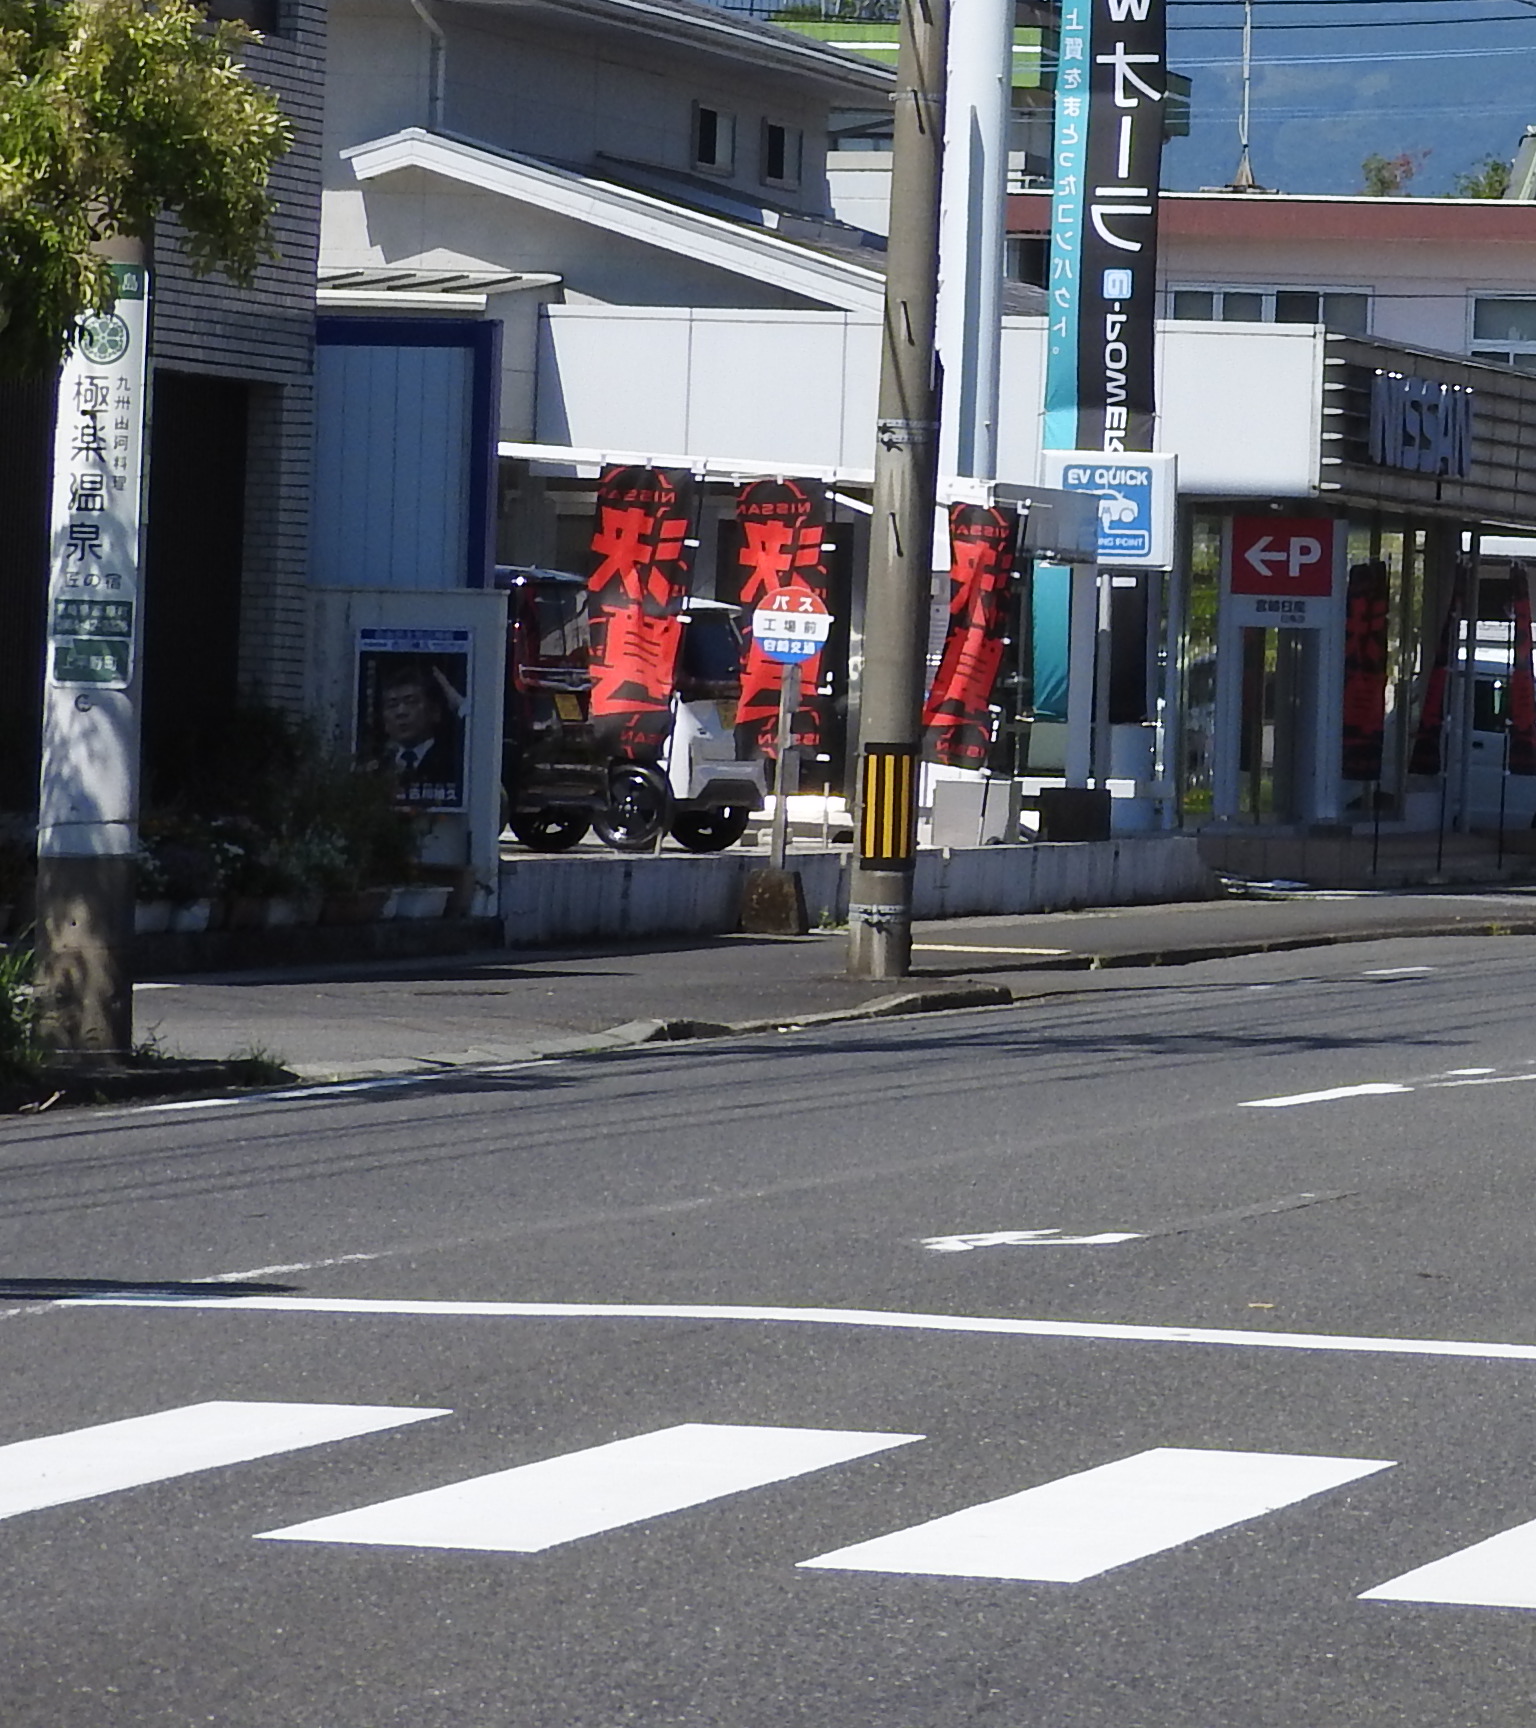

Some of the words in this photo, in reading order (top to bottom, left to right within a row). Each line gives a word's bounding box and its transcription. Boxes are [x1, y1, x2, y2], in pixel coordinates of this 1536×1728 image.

[1369, 370, 1473, 479] NISSAN
[67, 373, 110, 562] 極楽温泉
[1068, 468, 1091, 484] EV
[1095, 469, 1148, 485] QUICK
[1289, 536, 1322, 577] P
[773, 595, 814, 612] バス
